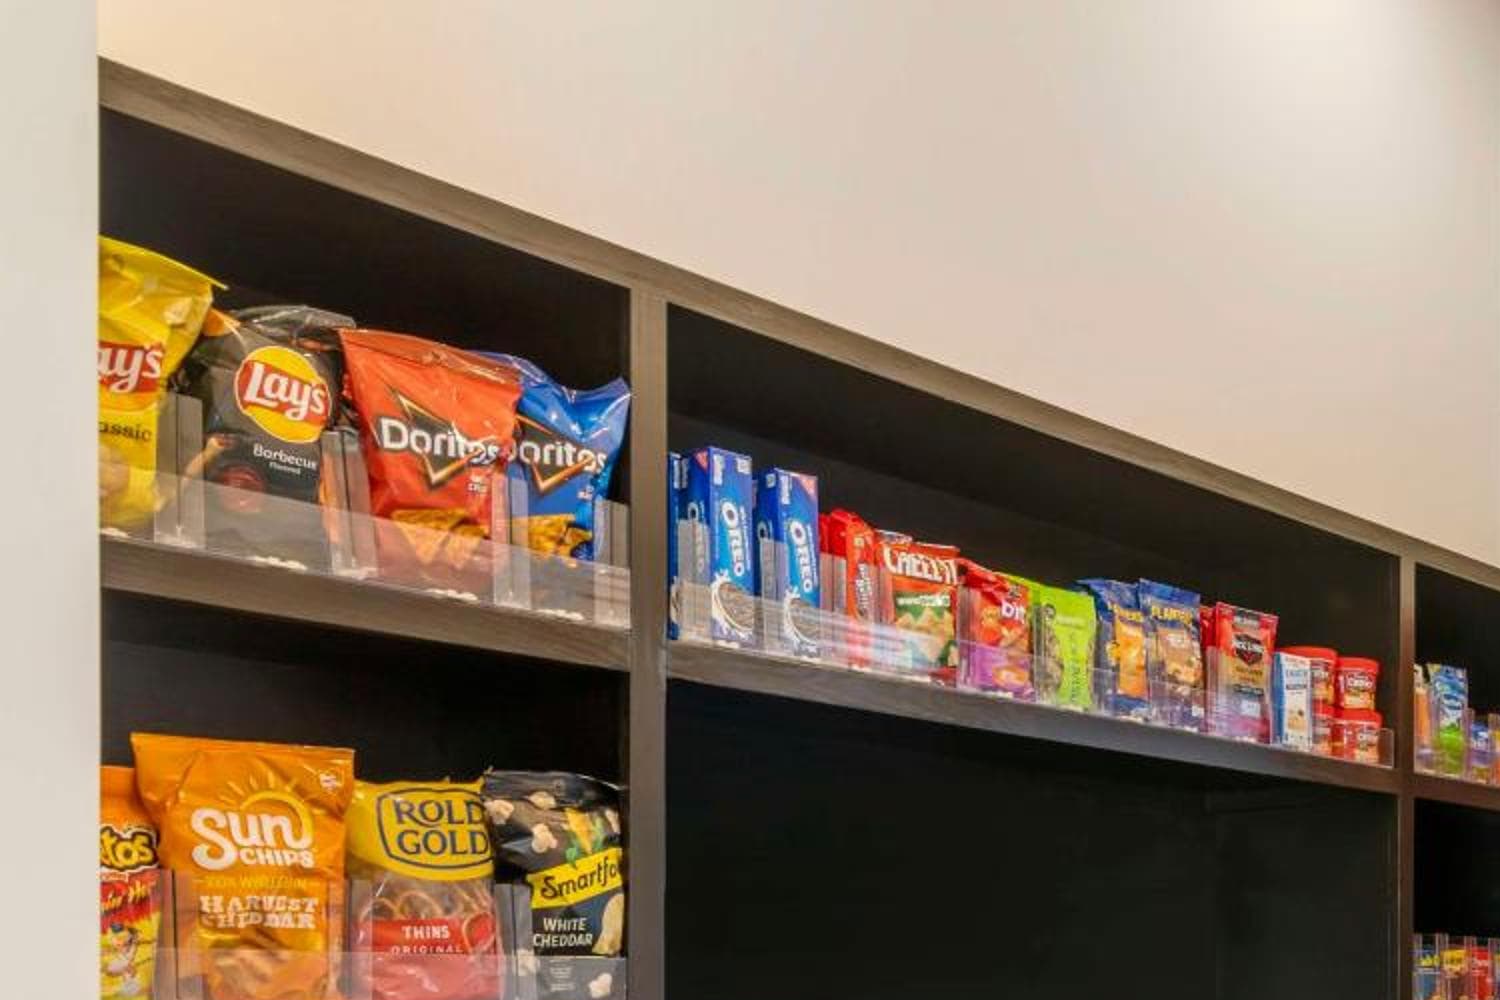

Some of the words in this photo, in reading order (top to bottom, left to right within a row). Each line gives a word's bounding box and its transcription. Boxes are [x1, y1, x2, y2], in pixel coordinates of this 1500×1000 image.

[243, 361, 325, 421] Lay's
[379, 416, 499, 465] Doritos
[392, 799, 488, 828] ROLD
[191, 807, 314, 871] Sun
[396, 830, 490, 855] GOLD
[239, 850, 316, 869] CHIPS
[402, 924, 451, 941] THINS
[543, 917, 587, 932] WHITE
[390, 944, 464, 954] ORIGINAL
[532, 933, 594, 948] CHEDDAR
